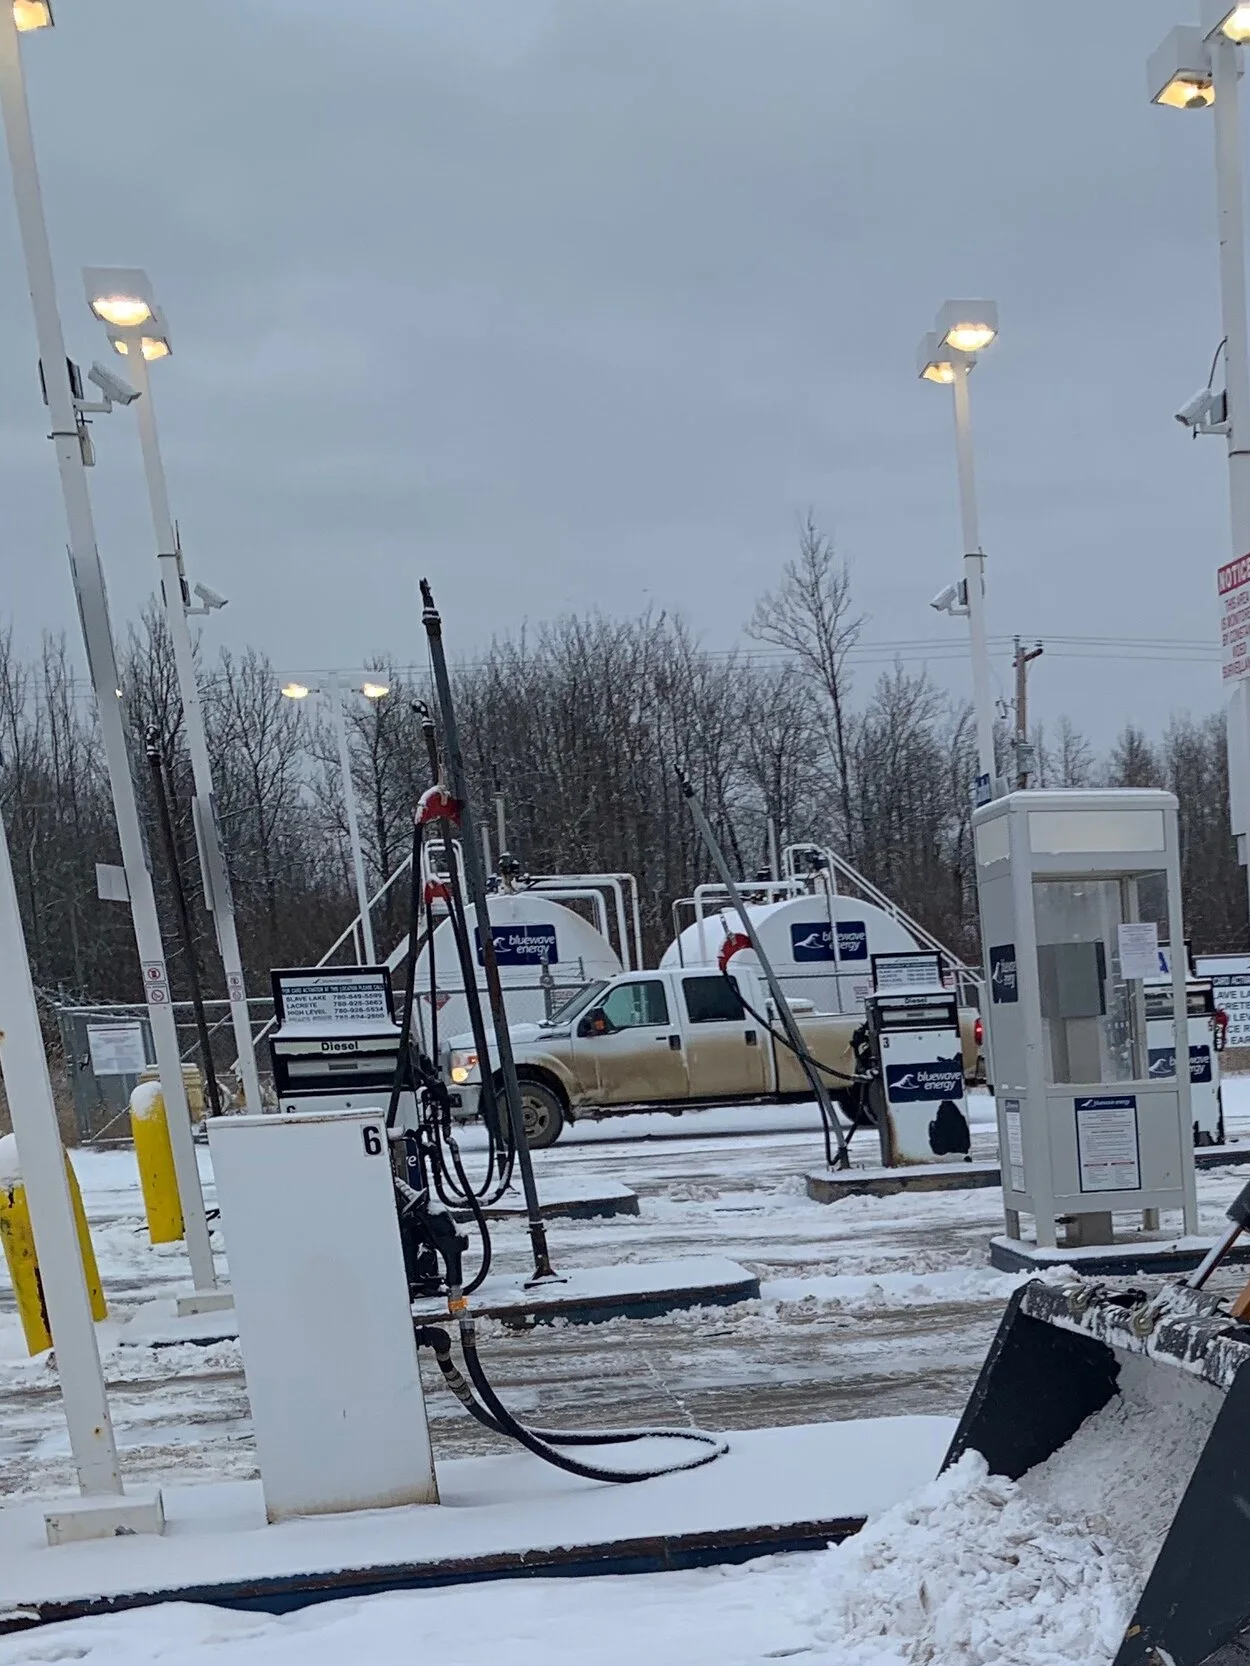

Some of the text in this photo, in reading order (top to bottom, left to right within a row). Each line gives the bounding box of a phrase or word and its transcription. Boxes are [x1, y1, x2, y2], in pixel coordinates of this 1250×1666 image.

[508, 934, 555, 946] bluewave
[516, 945, 550, 956] energy
[321, 1041, 359, 1051] Diesel
[883, 1037, 890, 1049] 3
[917, 1071, 962, 1082] bluewave
[924, 1081, 956, 1092] energy
[363, 1126, 381, 1155] 6
